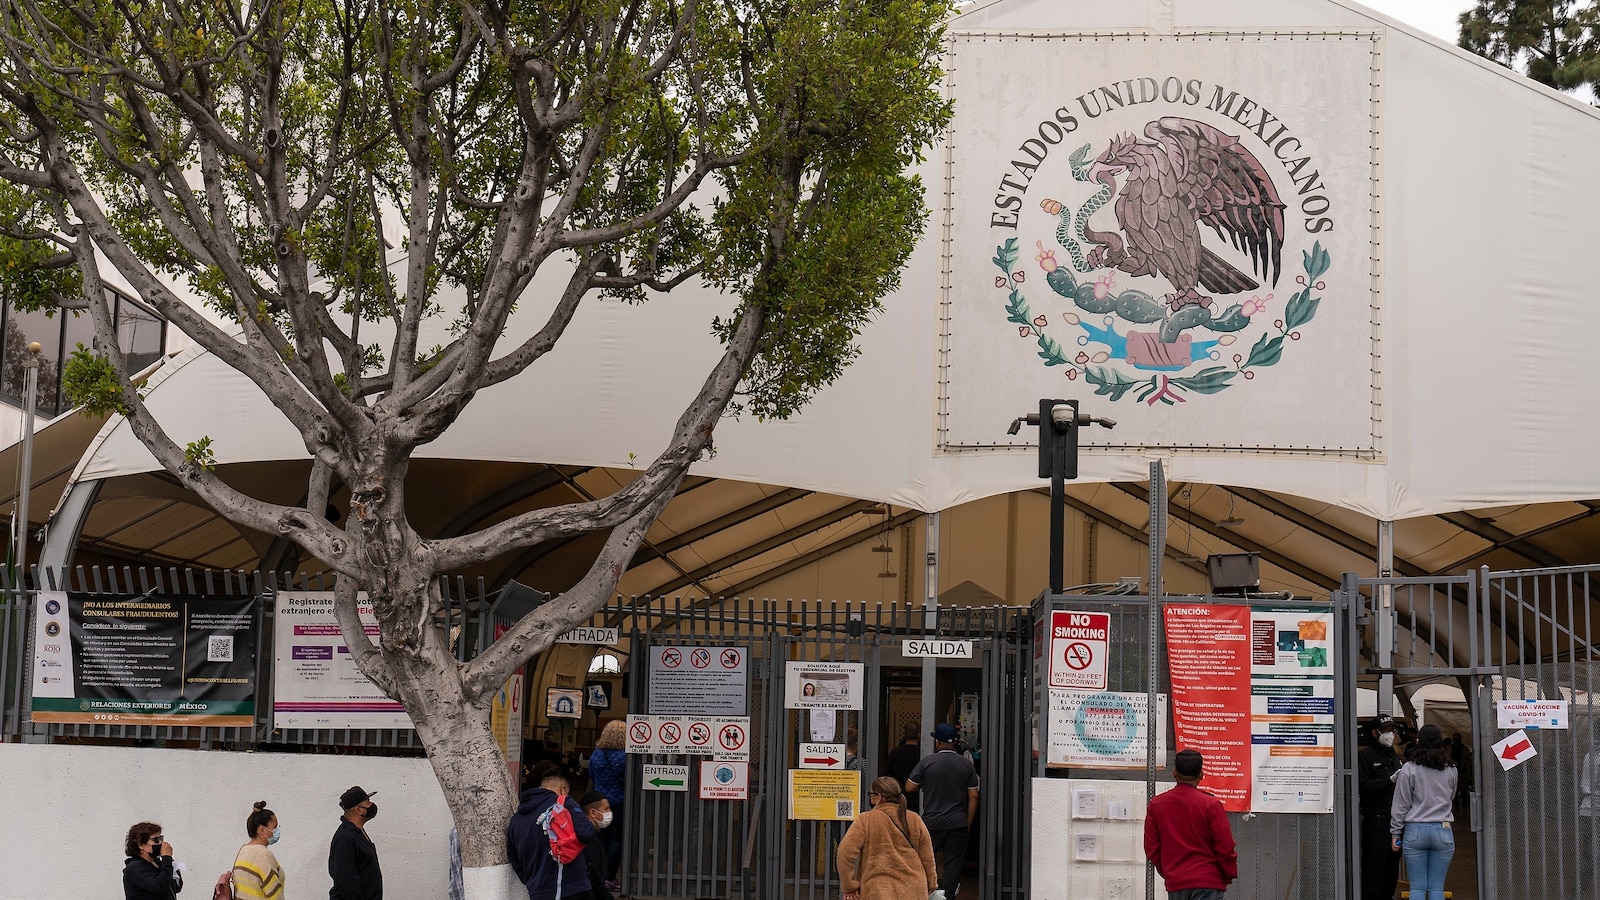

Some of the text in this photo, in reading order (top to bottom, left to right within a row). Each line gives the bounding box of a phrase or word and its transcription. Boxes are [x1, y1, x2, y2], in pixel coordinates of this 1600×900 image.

[990, 76, 1334, 234] ESTADOS UNIDOS MEXICANOS
[281, 607, 325, 615] extranjero
[1167, 607, 1210, 615] ATENCIÓN:
[1070, 614, 1091, 627] NO
[556, 629, 613, 642] NTRADA
[1054, 627, 1105, 640] SMOKING
[908, 642, 967, 656] SALIDA
[1066, 678, 1098, 686] DOORWAY
[132, 702, 172, 710] EXTERIORES
[179, 702, 207, 710] MÉXICO
[806, 746, 838, 754] SALIDA
[644, 767, 687, 776] ENTRADA
